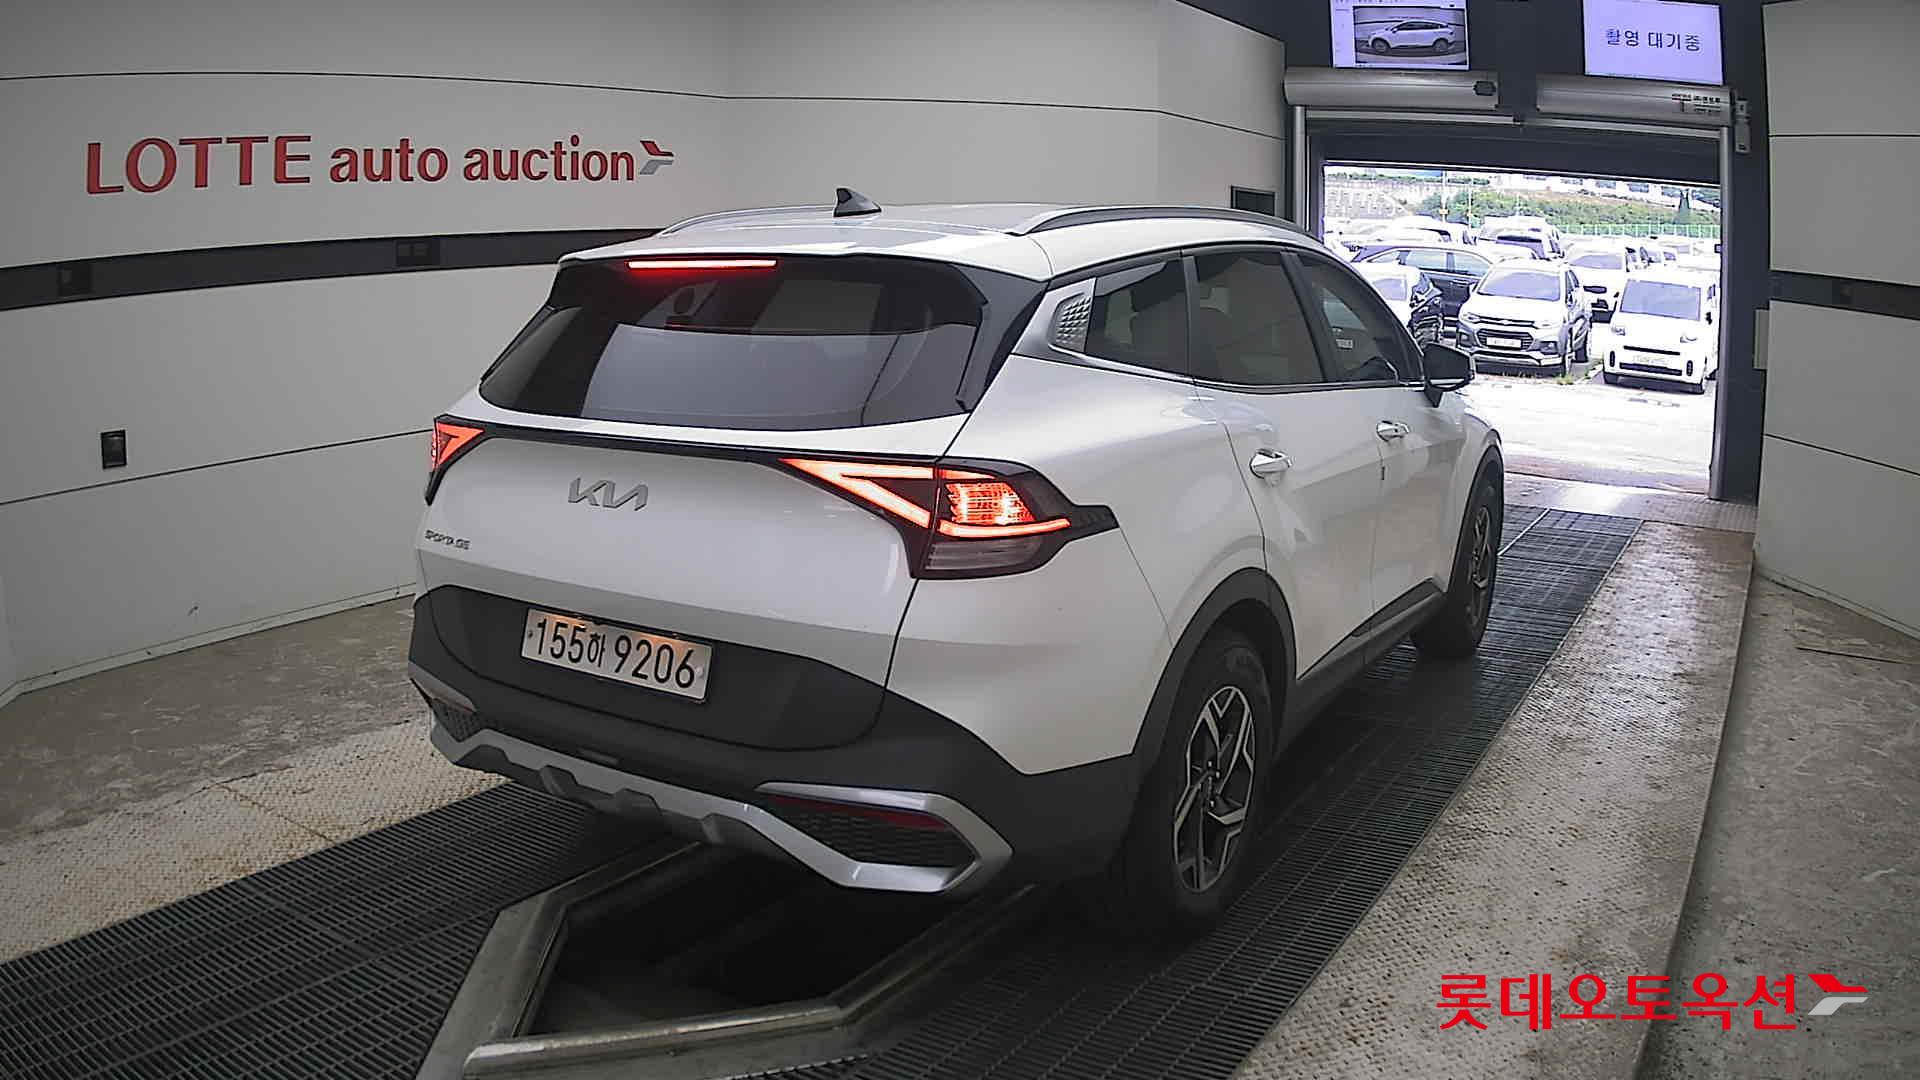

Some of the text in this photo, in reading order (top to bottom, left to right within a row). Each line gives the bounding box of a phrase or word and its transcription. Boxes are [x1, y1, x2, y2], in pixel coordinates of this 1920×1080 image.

[86, 134, 635, 195] LOTTE auto auction
[568, 477, 649, 512] KIA
[537, 618, 695, 689] 155하 9206
